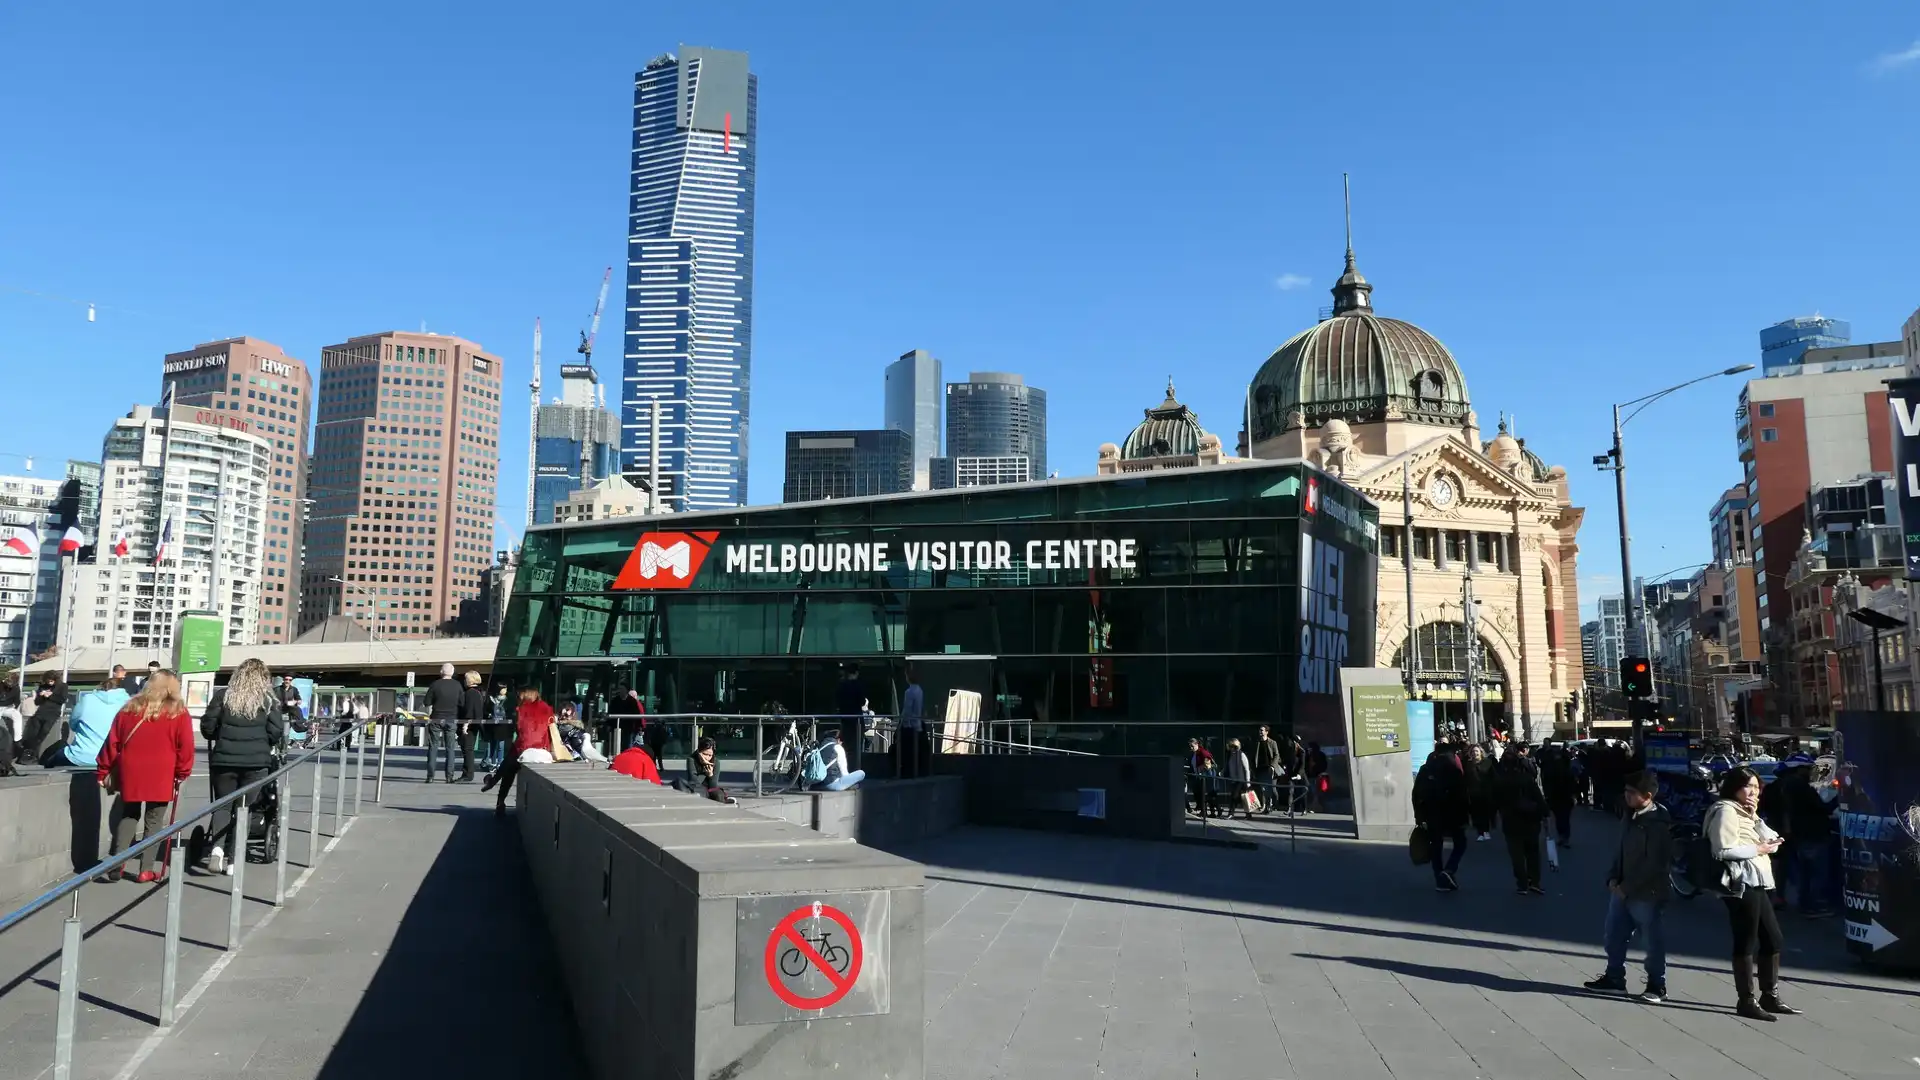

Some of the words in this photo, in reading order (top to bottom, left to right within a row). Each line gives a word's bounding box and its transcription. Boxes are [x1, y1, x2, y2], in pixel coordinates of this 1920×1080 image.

[163, 359, 203, 373] HERALD
[205, 354, 226, 368] SUN
[261, 358, 293, 377] HWT
[726, 543, 889, 573] MELBOURNE
[904, 540, 1011, 571] VISITOR
[1026, 539, 1136, 569] CENTRE
[1301, 533, 1349, 632] MEL
[1850, 925, 1869, 939] WAY
